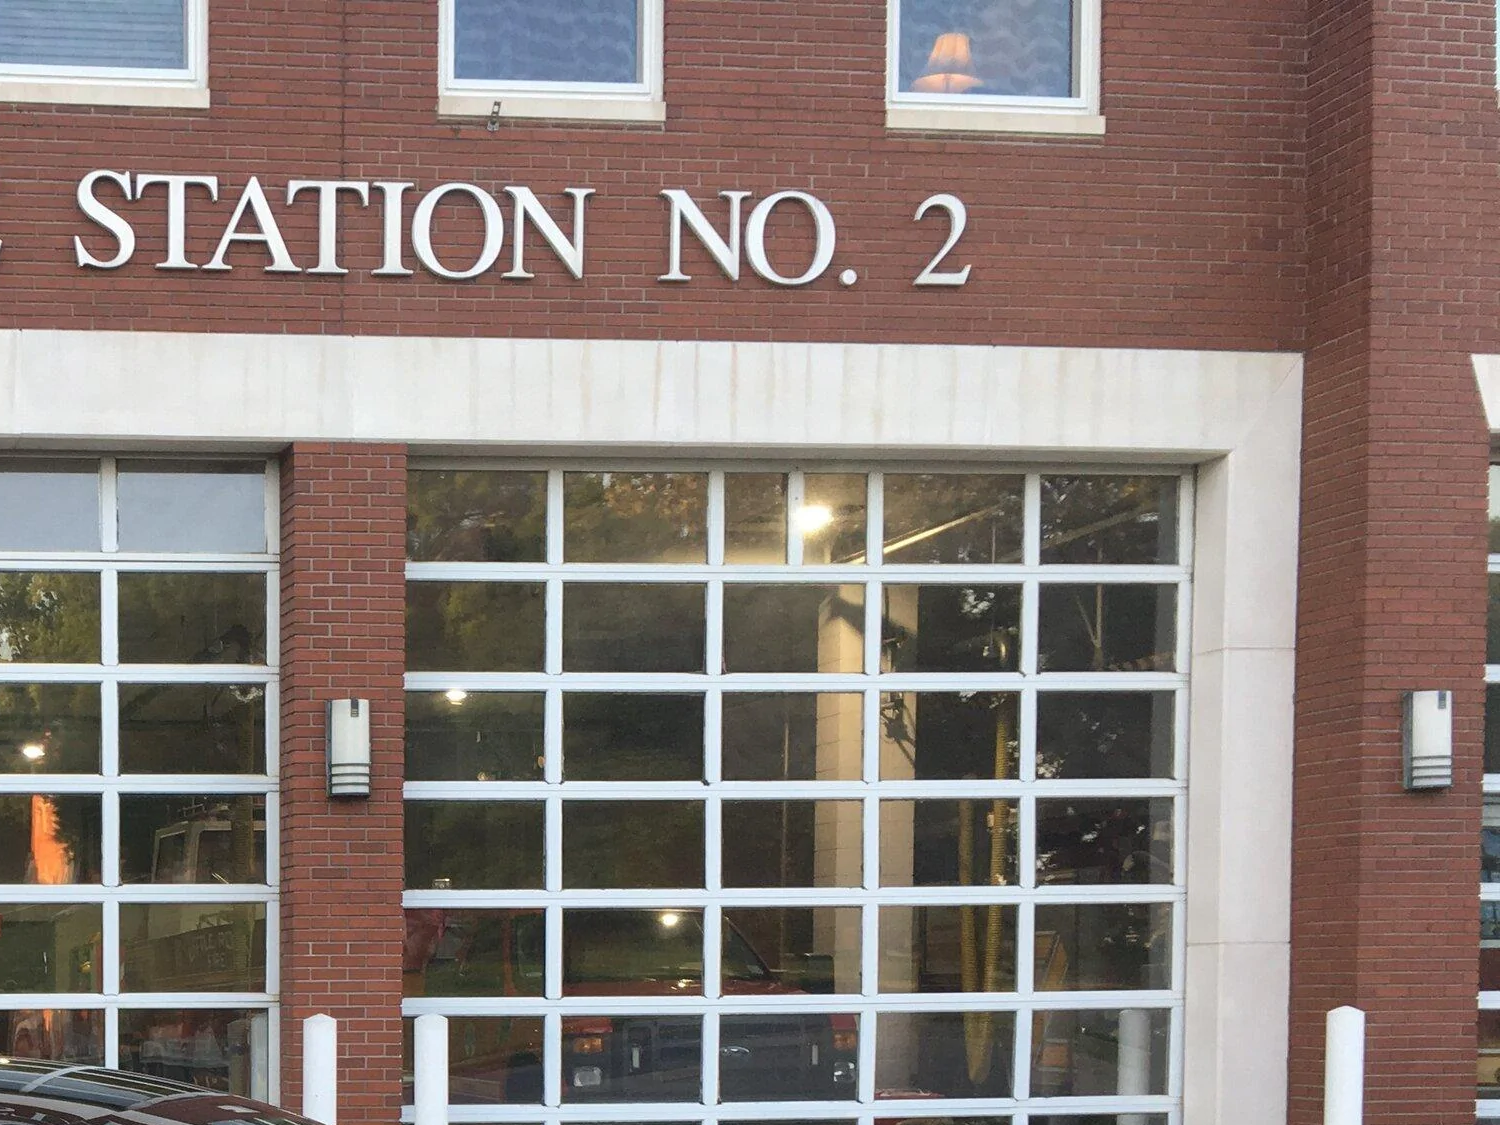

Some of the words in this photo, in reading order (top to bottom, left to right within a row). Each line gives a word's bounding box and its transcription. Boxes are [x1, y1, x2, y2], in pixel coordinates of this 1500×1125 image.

[73, 168, 597, 280] STATION
[657, 187, 858, 287] NO.
[912, 193, 972, 287] 2
